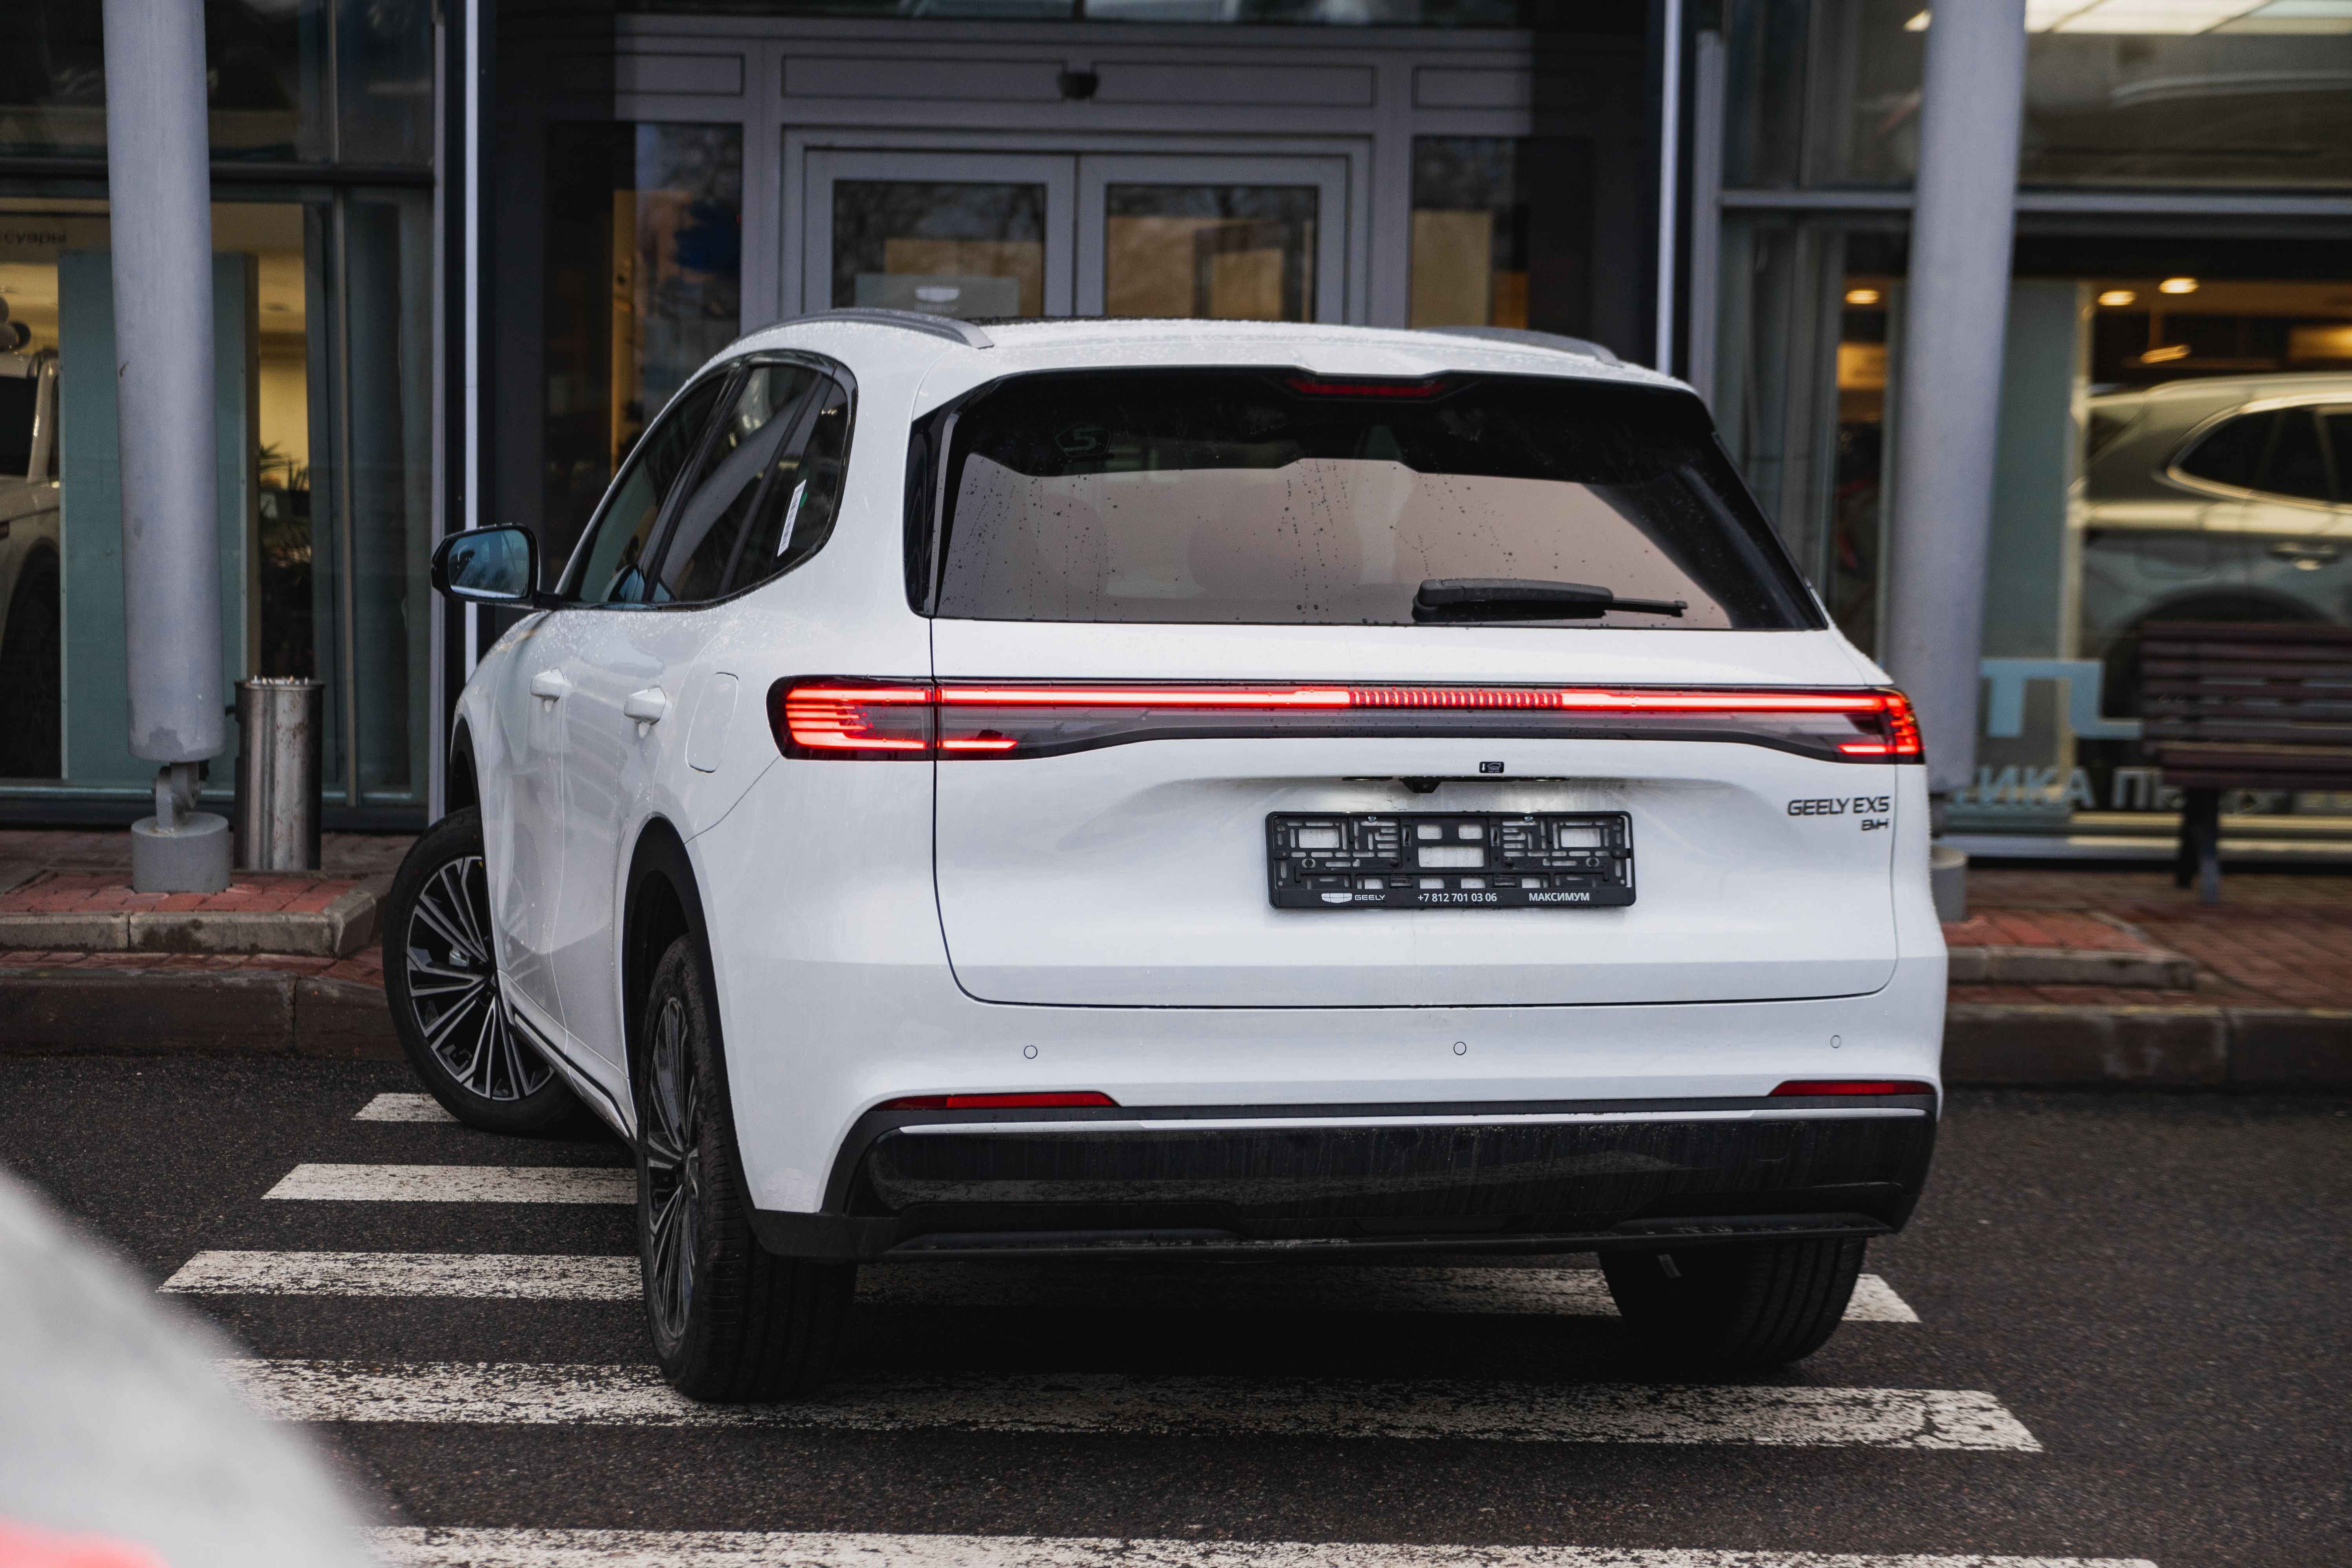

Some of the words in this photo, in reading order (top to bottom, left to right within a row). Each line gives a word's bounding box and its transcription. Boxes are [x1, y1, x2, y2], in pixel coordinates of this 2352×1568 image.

[1787, 798, 1850, 816] GEELY
[1853, 796, 1891, 814] EX5
[1417, 893, 1429, 902] +7
[1432, 893, 1449, 902] 812
[1451, 893, 1468, 902] 701
[1471, 893, 1483, 902] 03
[1485, 893, 1497, 902] 06
[1528, 892, 1590, 902] МАКСИМУМ
